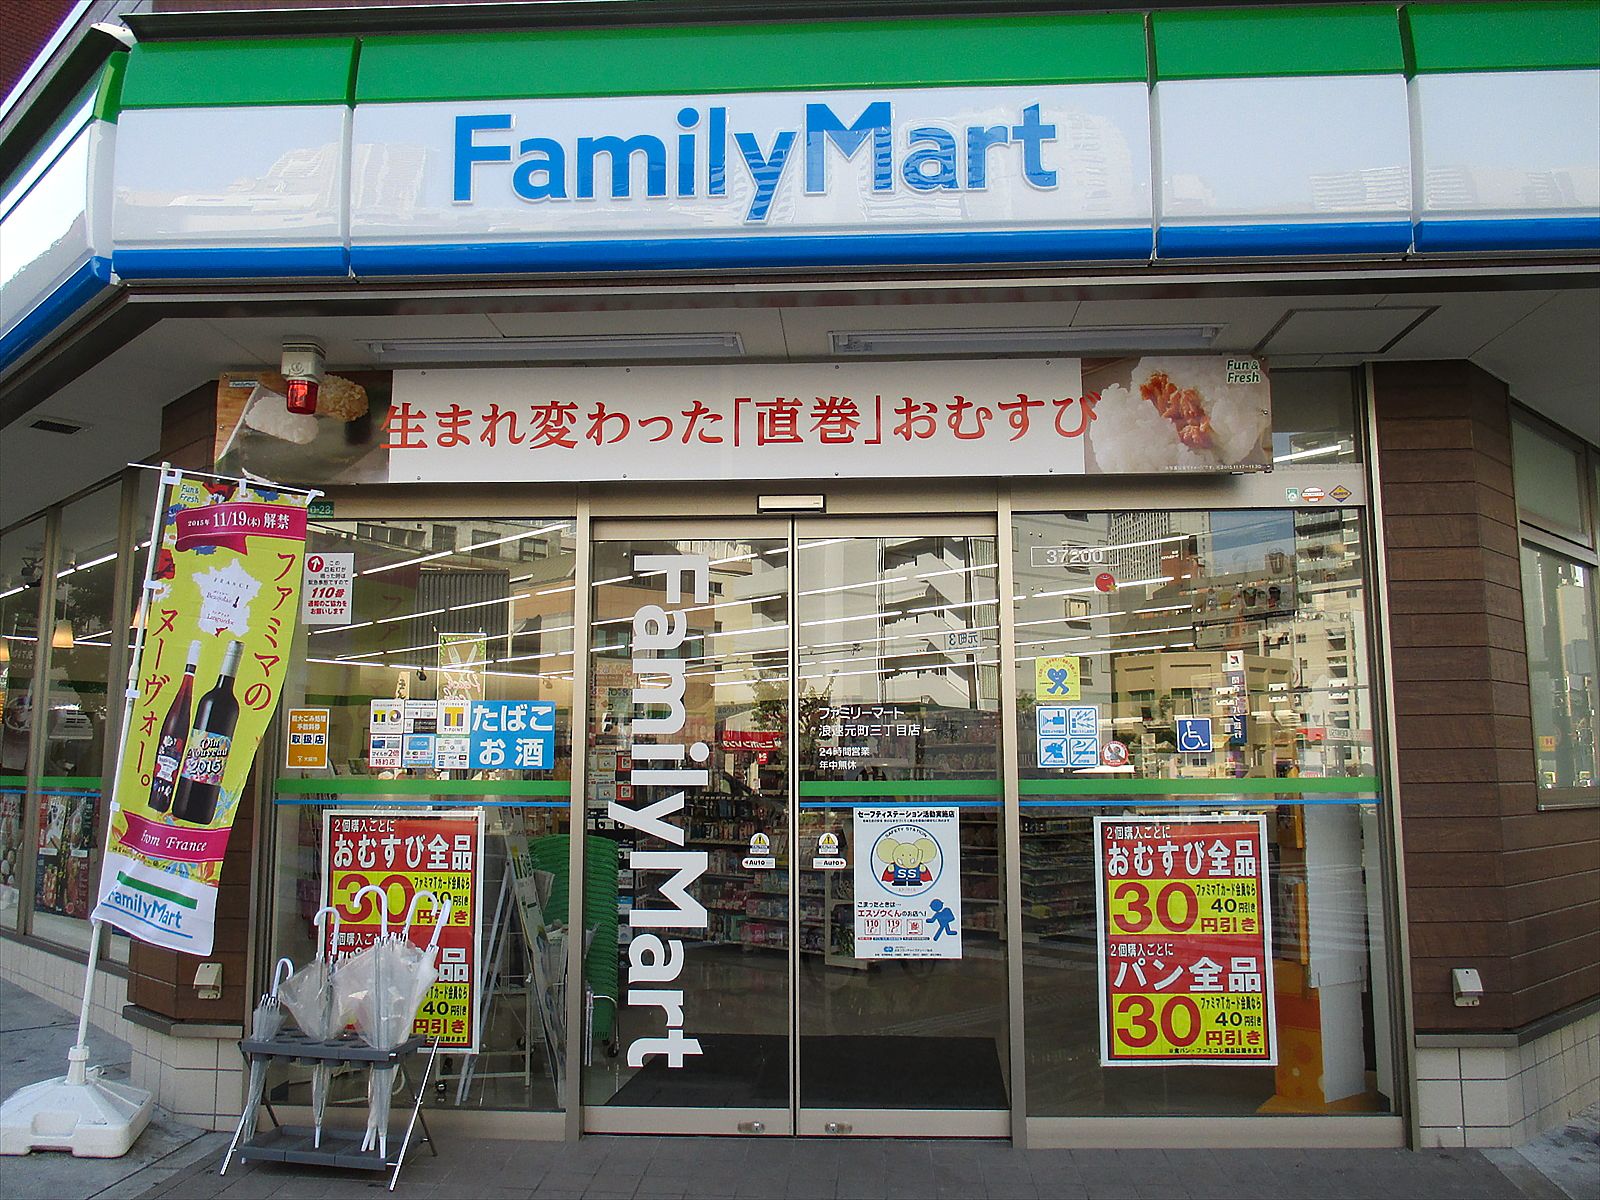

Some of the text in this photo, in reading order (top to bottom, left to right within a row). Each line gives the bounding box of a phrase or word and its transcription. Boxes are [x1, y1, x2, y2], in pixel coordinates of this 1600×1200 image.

[452, 102, 1058, 224] FamilyMart
[1227, 372, 1259, 382] Fresh
[379, 390, 1101, 451] 生まれ変わった「直巻」おむすび
[180, 493, 199, 503] Fresh
[263, 513, 290, 530] 解禁
[1046, 549, 1103, 564] 37200
[312, 587, 345, 599] 110番
[243, 552, 297, 712] ファミマの
[472, 704, 553, 732] たばこ
[818, 706, 904, 720] ファミリーマート
[818, 724, 920, 737] 浪速元町三丁目店
[292, 734, 324, 744] 取扱店
[479, 738, 544, 767] お酒
[818, 747, 870, 757] 24時間営業
[189, 760, 222, 774] 2015
[818, 760, 857, 770] 年中無休
[608, 554, 708, 1068] FamilyMart
[857, 810, 955, 818] セーフティステーション活動実施店
[334, 819, 395, 833] 2個購入ごとに
[885, 826, 927, 838] SAFETY STATION
[1106, 826, 1171, 840] 2個購入ごとに
[141, 830, 207, 852] from France
[334, 833, 473, 871] おむすび全品
[1107, 839, 1257, 877] おむすび全品
[337, 873, 415, 923] 30
[1113, 882, 1199, 933] 30
[887, 920, 900, 928] 119
[1200, 917, 1256, 934] 円引き
[1110, 943, 1174, 957] 2個購入ごとに
[1113, 956, 1262, 992] パン全品
[412, 1018, 466, 1035] 円引き
[1116, 995, 1202, 1048] 30
[1205, 1030, 1262, 1046] 円引き
